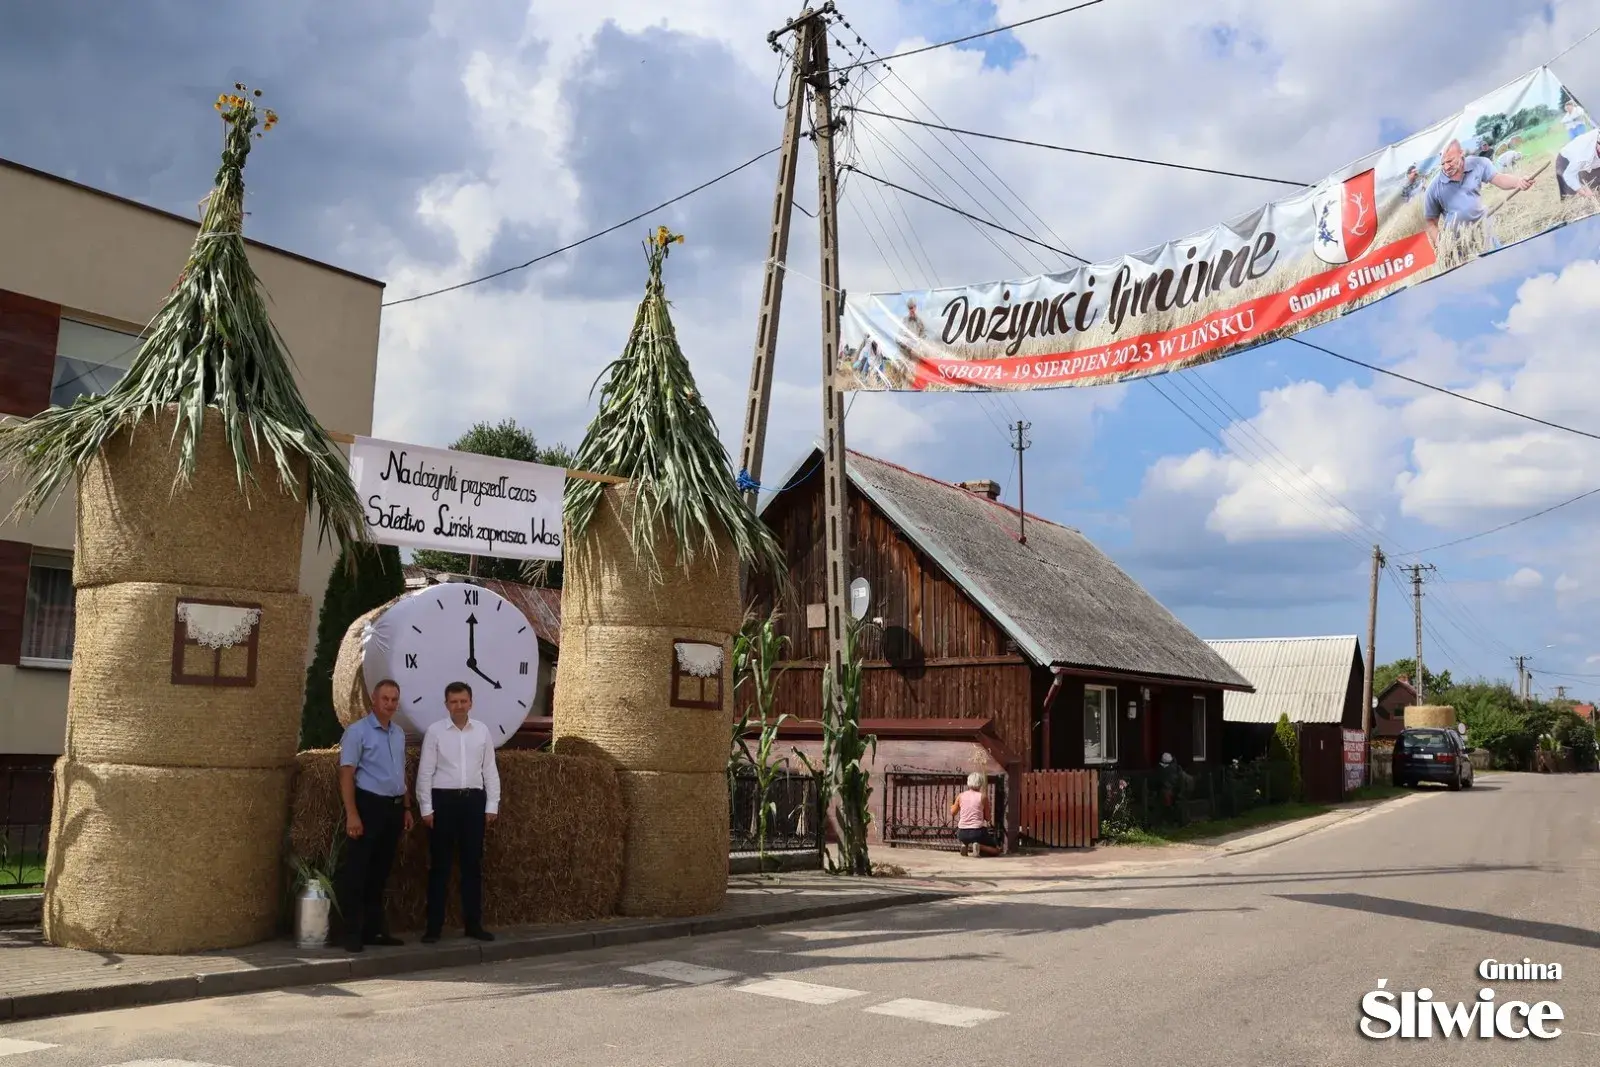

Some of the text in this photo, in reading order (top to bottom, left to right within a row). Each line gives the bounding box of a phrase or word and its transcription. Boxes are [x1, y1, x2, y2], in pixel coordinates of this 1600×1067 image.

[1288, 252, 1415, 314] Gmina Śliwice
[1012, 361, 1031, 379] 19
[1032, 350, 1111, 378] SIERPIEŃ
[1113, 342, 1154, 367] 2023
[1157, 336, 1179, 357] W
[1180, 308, 1255, 351] LIŃSKU
[380, 450, 412, 484] Na
[508, 486, 537, 502] czas
[433, 504, 474, 538] Lińsk
[531, 517, 561, 546] Was
[463, 589, 479, 606] XII
[405, 653, 418, 669] IX
